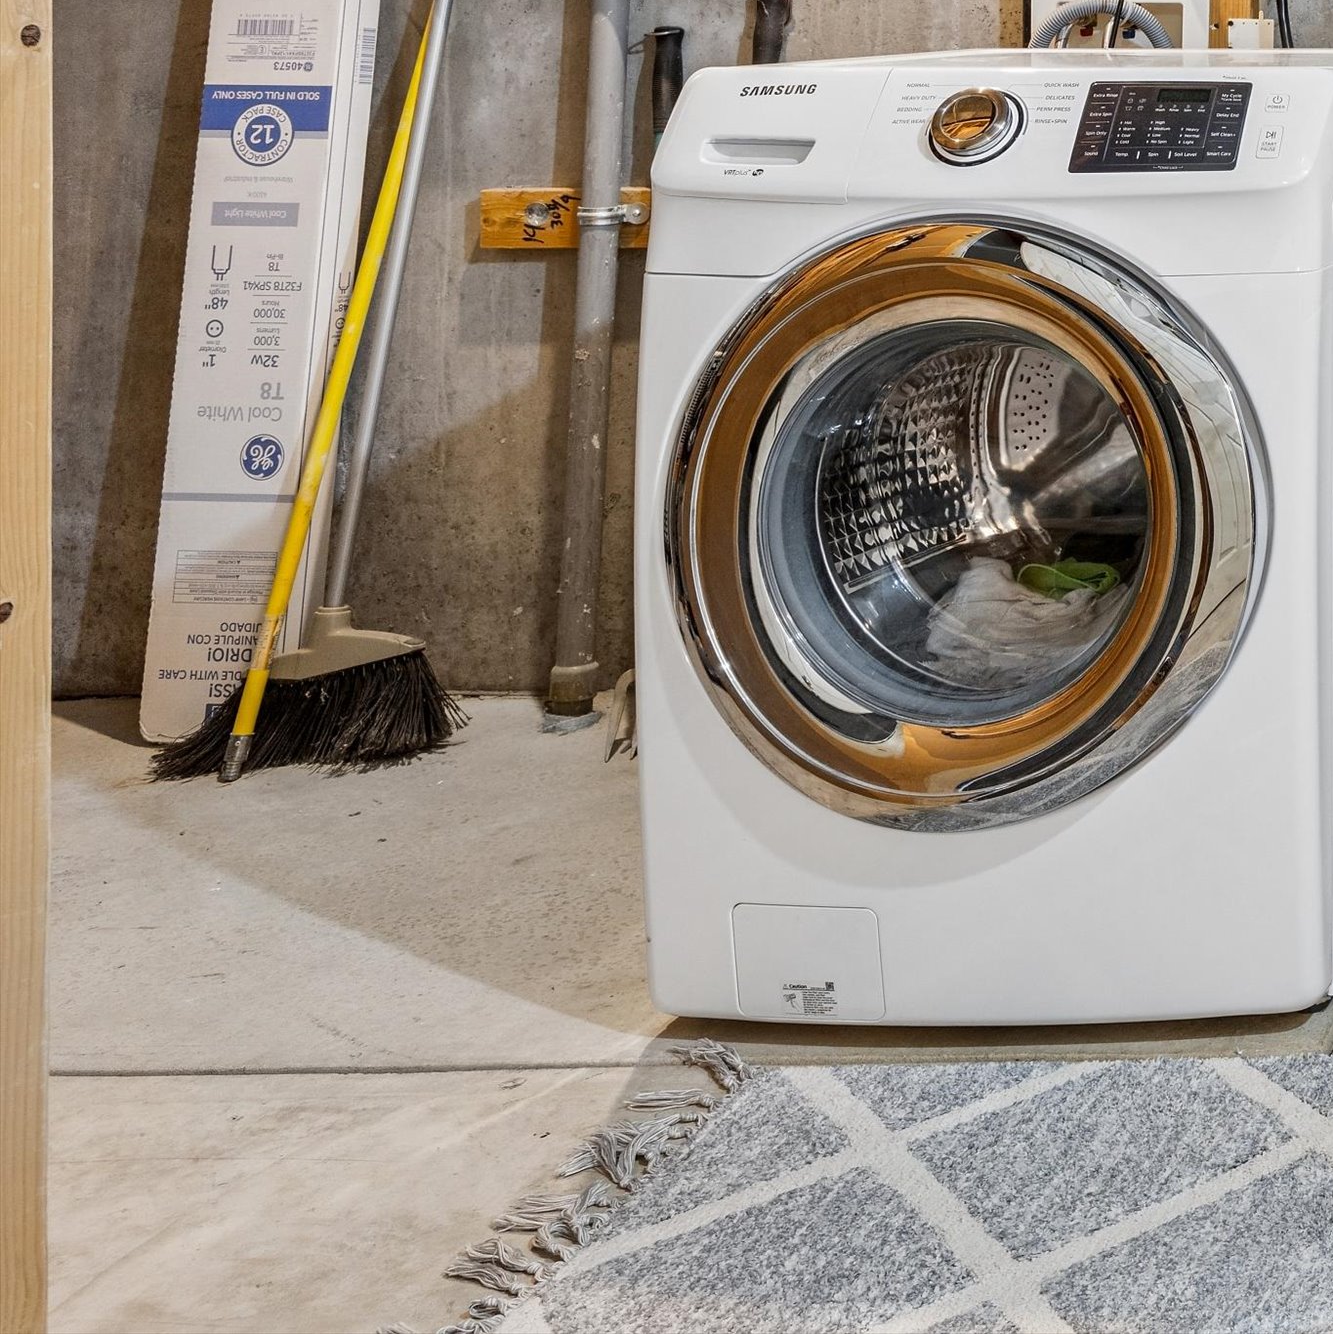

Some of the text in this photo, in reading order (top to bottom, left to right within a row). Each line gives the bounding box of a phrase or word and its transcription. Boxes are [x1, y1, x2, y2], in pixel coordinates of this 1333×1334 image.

[273, 62, 302, 71] 40573
[212, 91, 320, 100] SOLD IN FULL CASES ONLY
[740, 84, 817, 97] SAMSUNG
[241, 106, 287, 123] CASE PACK
[250, 124, 275, 144] 12
[235, 138, 288, 162] CONTRACTOR
[224, 208, 287, 219] Cool White Light
[268, 261, 281, 272] T8
[243, 281, 302, 291] F32T8 SPX41
[204, 297, 229, 310] 48"
[253, 308, 286, 318] 30,000
[253, 336, 280, 346] 3,000
[202, 354, 216, 367] 1"
[260, 382, 284, 400] T8
[197, 406, 282, 423] Cool White
[187, 634, 258, 645] ANIPULE CON
[207, 647, 253, 662] DRIO!
[158, 669, 242, 680] DLE WITH CARE
